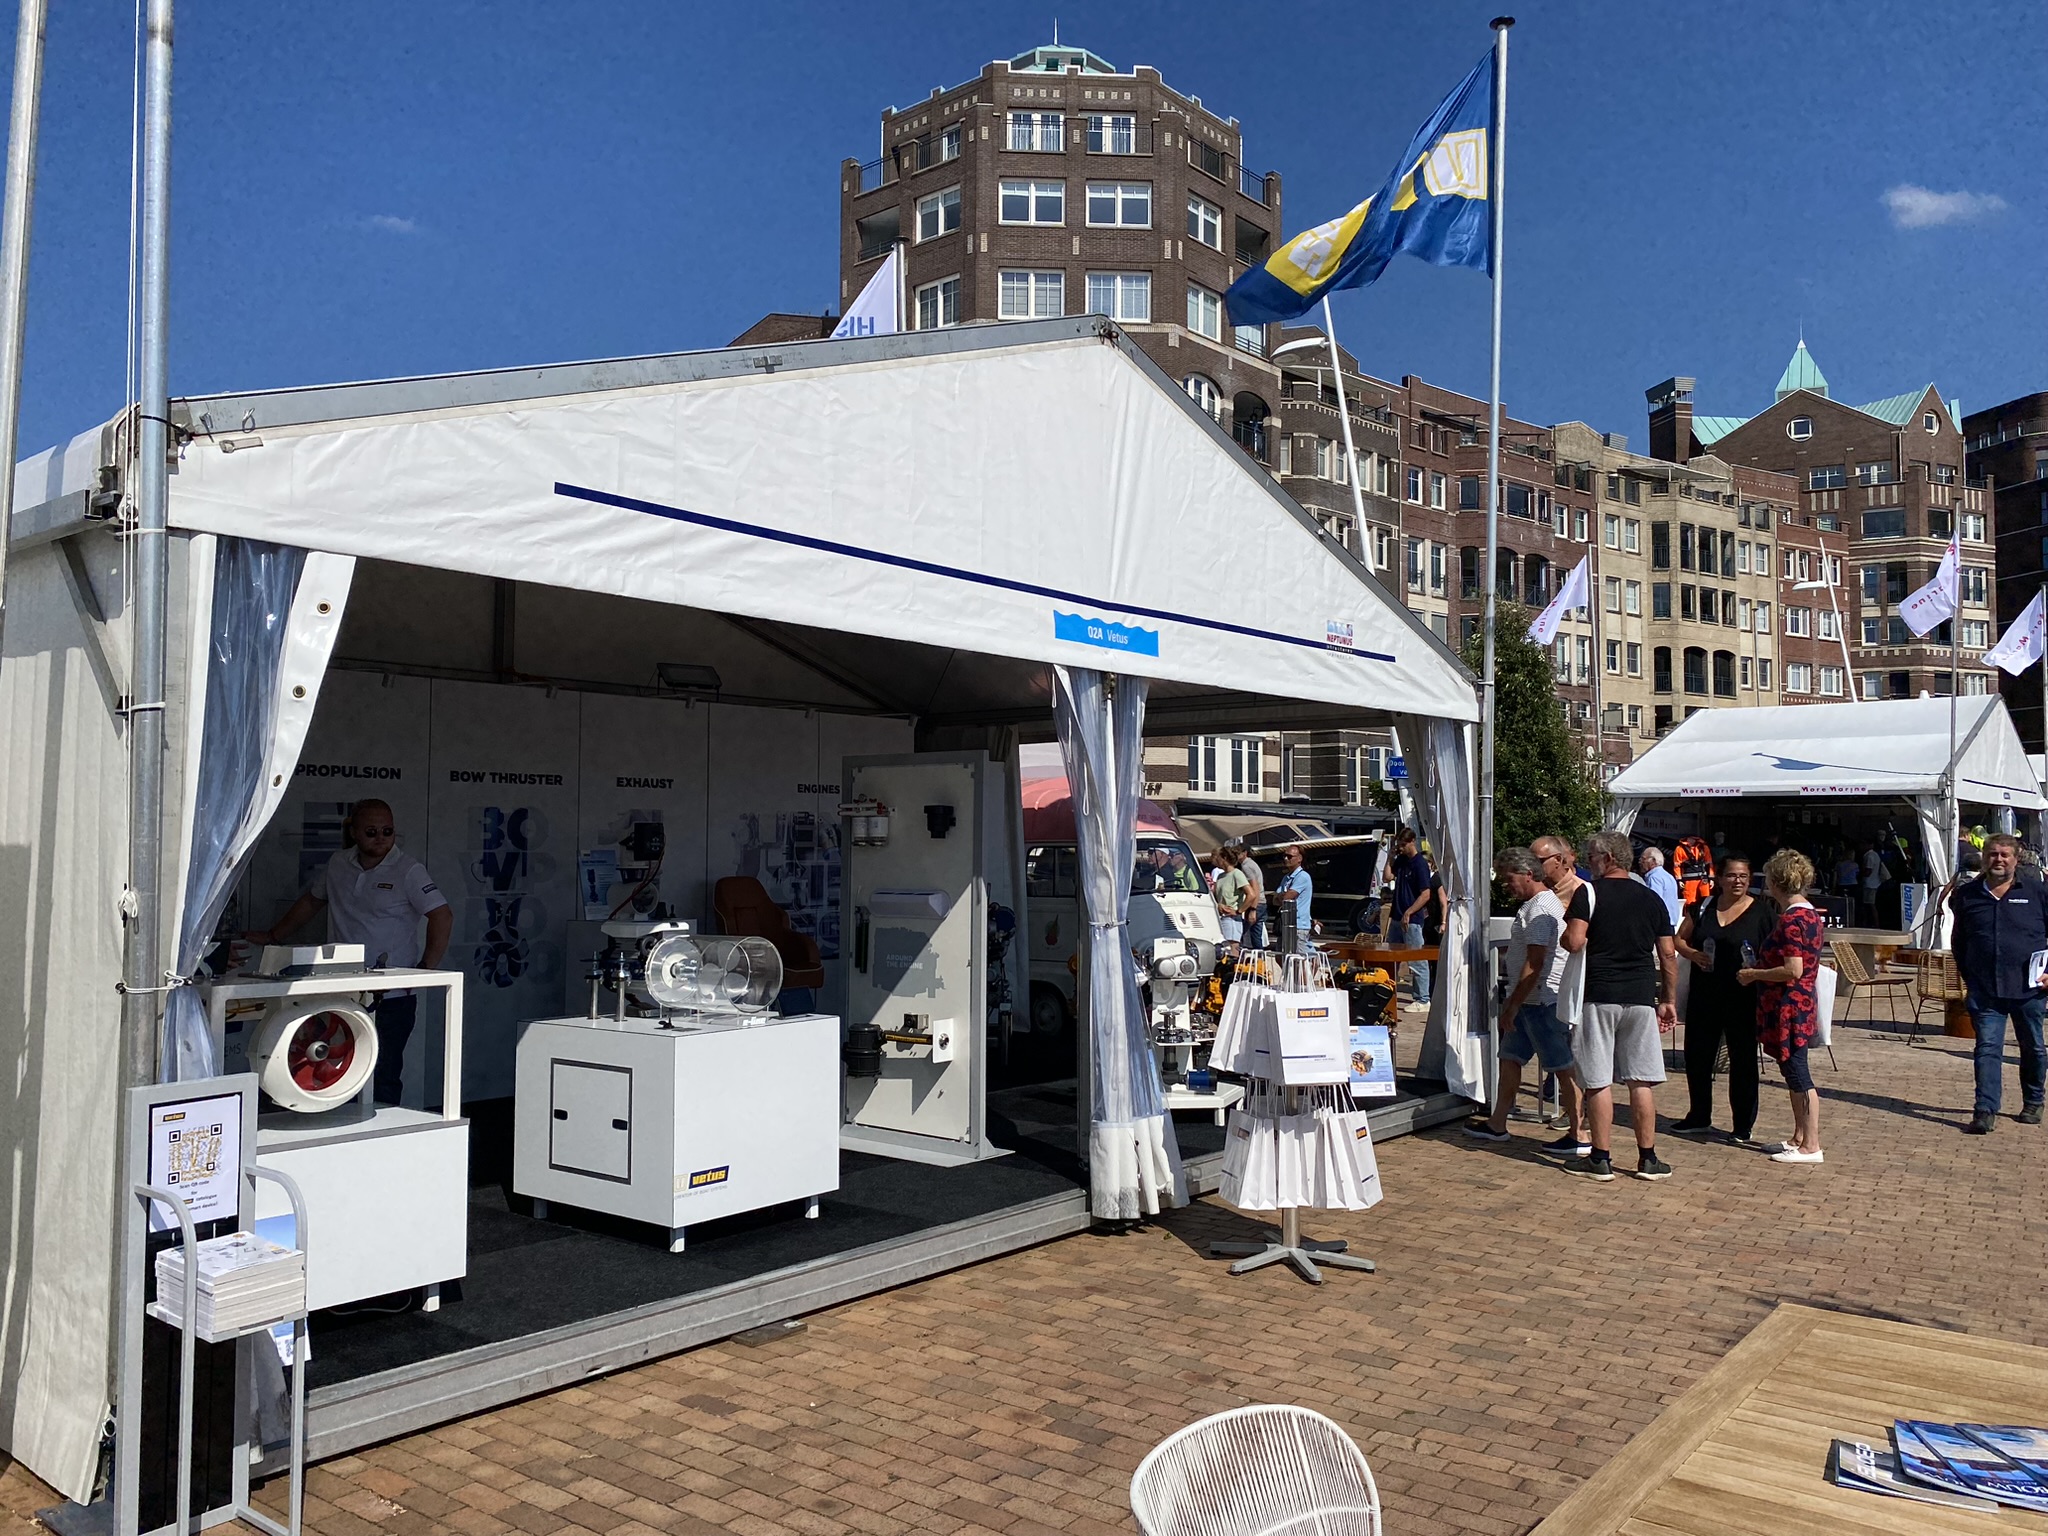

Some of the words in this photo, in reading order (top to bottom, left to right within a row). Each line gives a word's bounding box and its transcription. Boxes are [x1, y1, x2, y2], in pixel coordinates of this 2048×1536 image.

[1087, 625, 1103, 640] 02A
[1106, 629, 1128, 645] Vetus
[1326, 633, 1353, 646] NEPTUNUS
[294, 763, 402, 780] PROPULSION
[450, 770, 486, 784] BOW
[489, 772, 563, 786] THRUSTER
[616, 776, 674, 790] EXHAUST
[797, 783, 841, 795] ENGINES
[1829, 785, 1867, 794] Marine
[1707, 787, 1741, 796] Marine
[1903, 885, 1914, 922] bamar
[886, 953, 914, 962] AROUND
[692, 1170, 726, 1186] vetus
